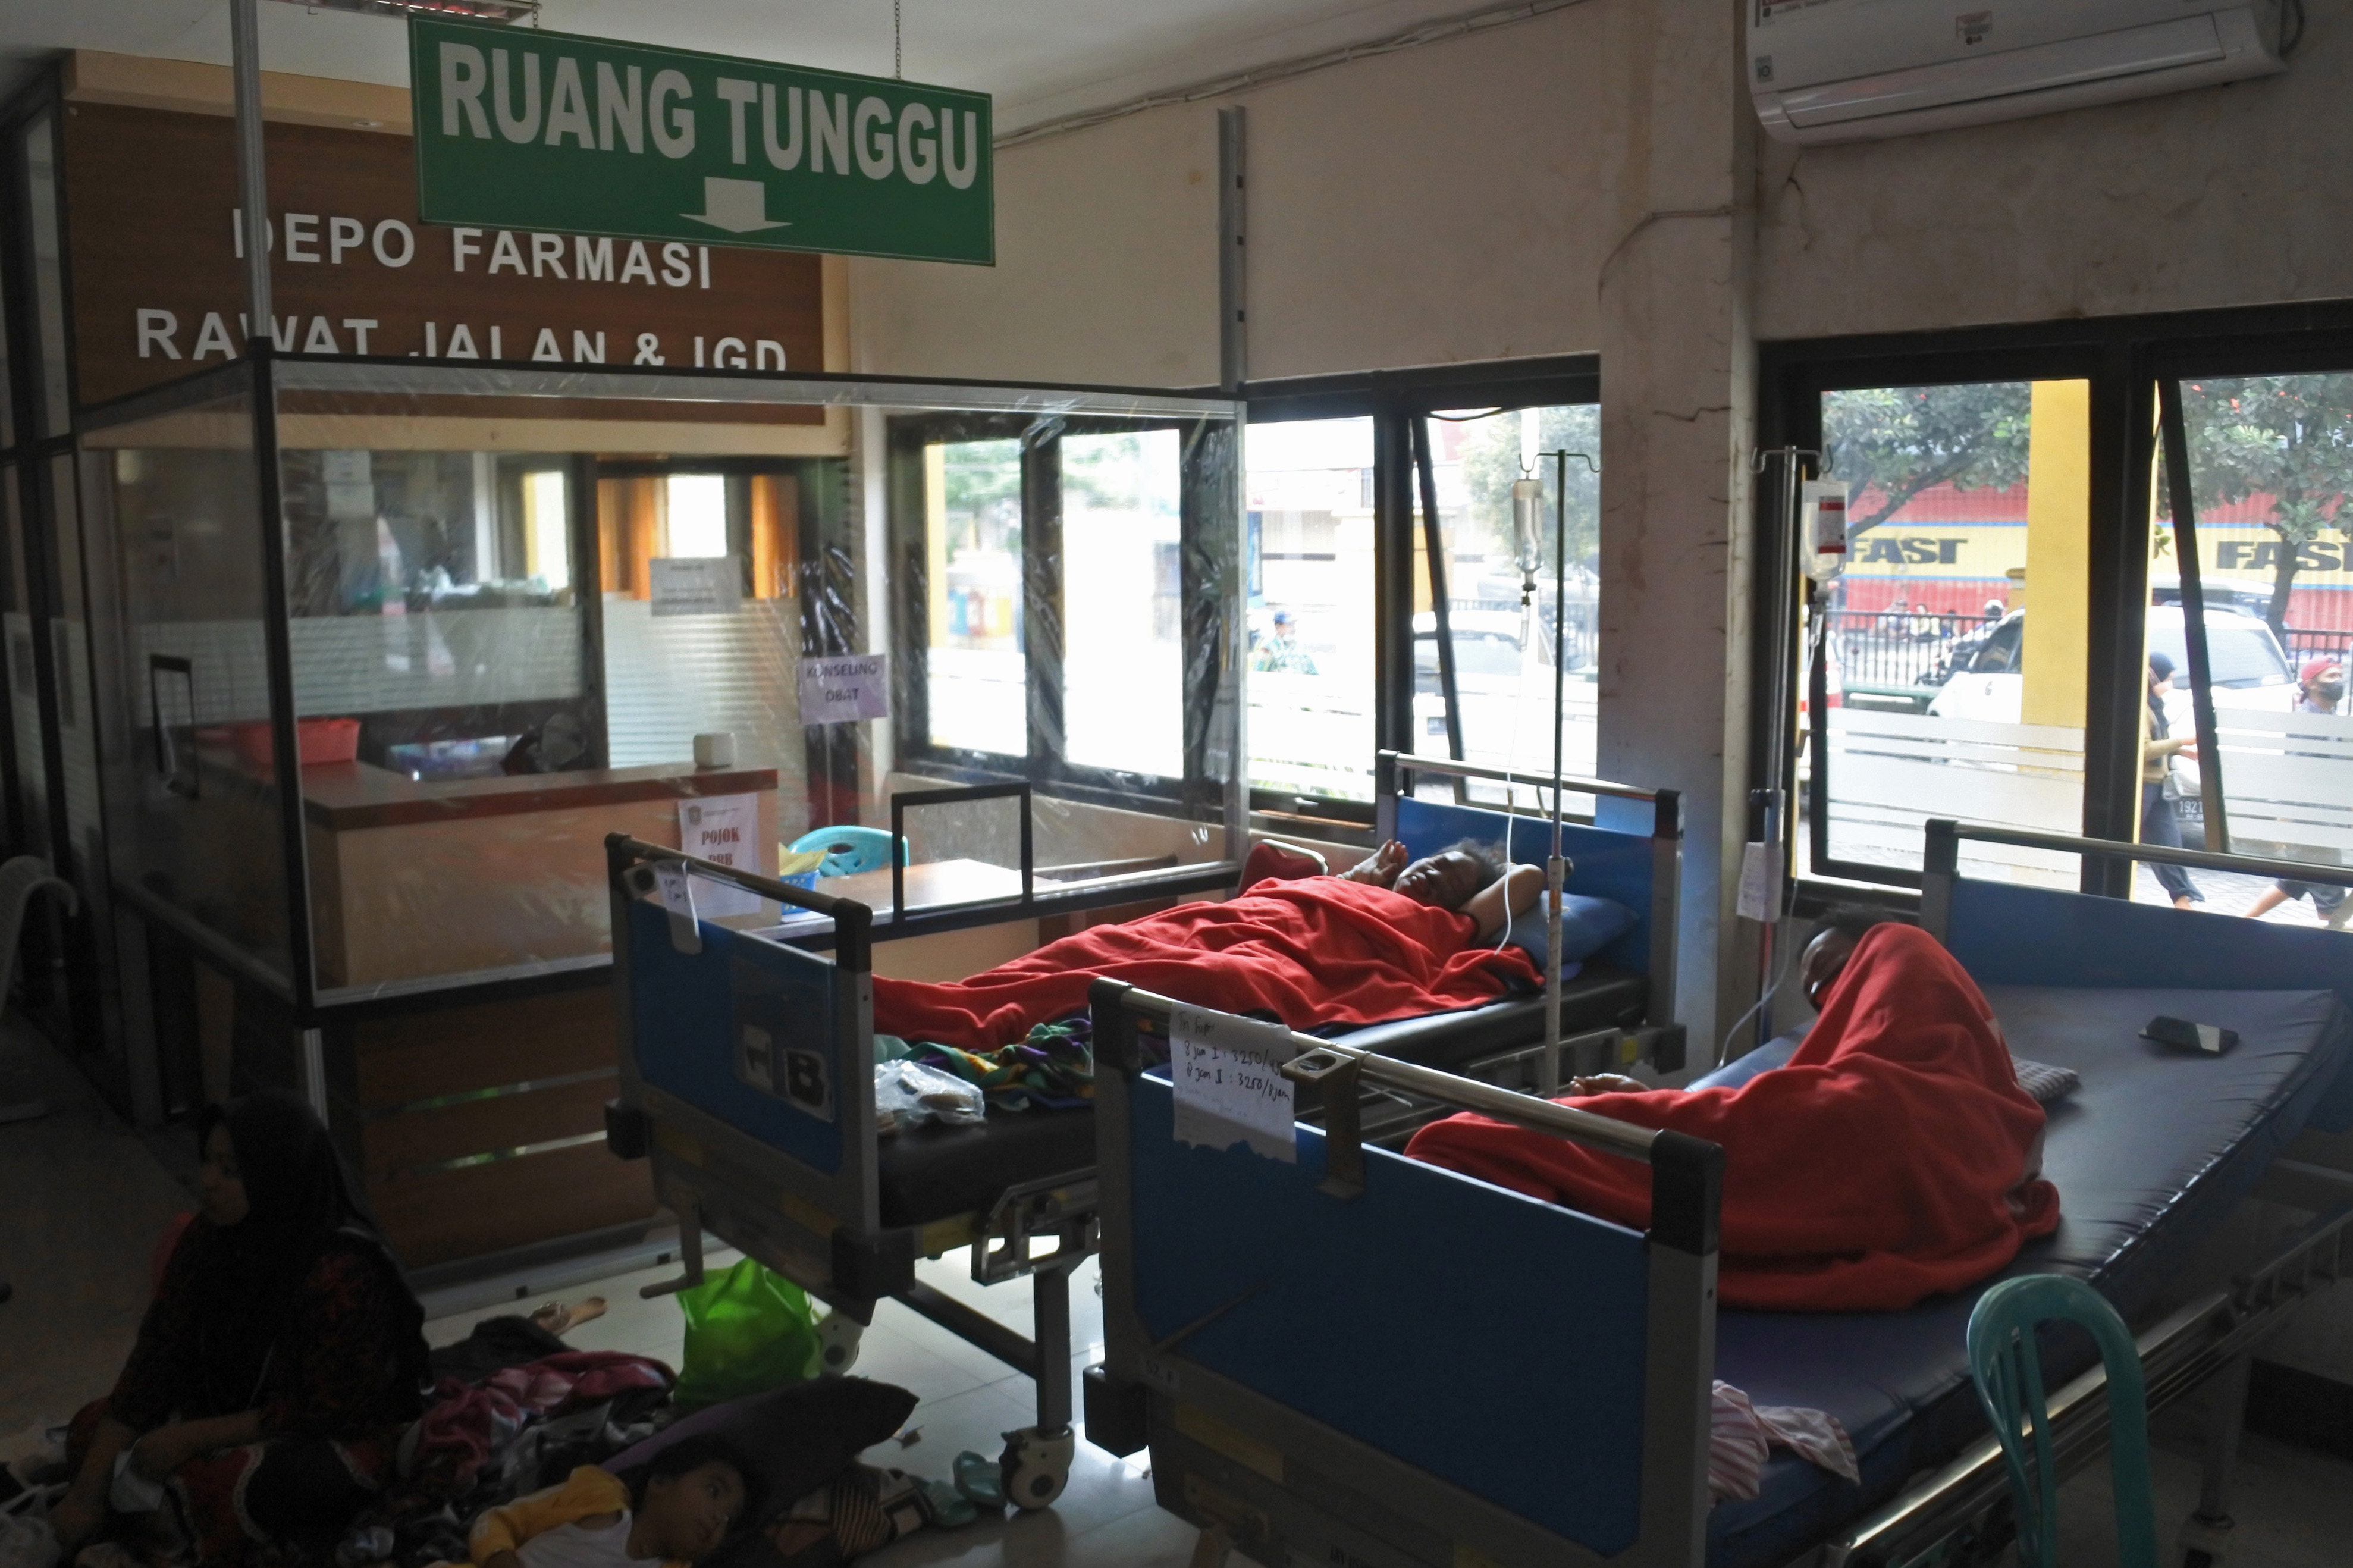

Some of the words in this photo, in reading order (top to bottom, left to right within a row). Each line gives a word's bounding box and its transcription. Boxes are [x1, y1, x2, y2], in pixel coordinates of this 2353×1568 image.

[439, 42, 696, 159] RUANG
[716, 77, 977, 189] TUNGGU
[453, 228, 711, 289] FARMASI
[633, 333, 666, 366] &
[694, 336, 786, 371] IGD
[1846, 537, 1968, 564] FAST
[807, 662, 877, 678] KONSELING
[826, 688, 859, 702] OBAT
[2179, 801, 2203, 813] 1921
[702, 827, 740, 845] POJOK
